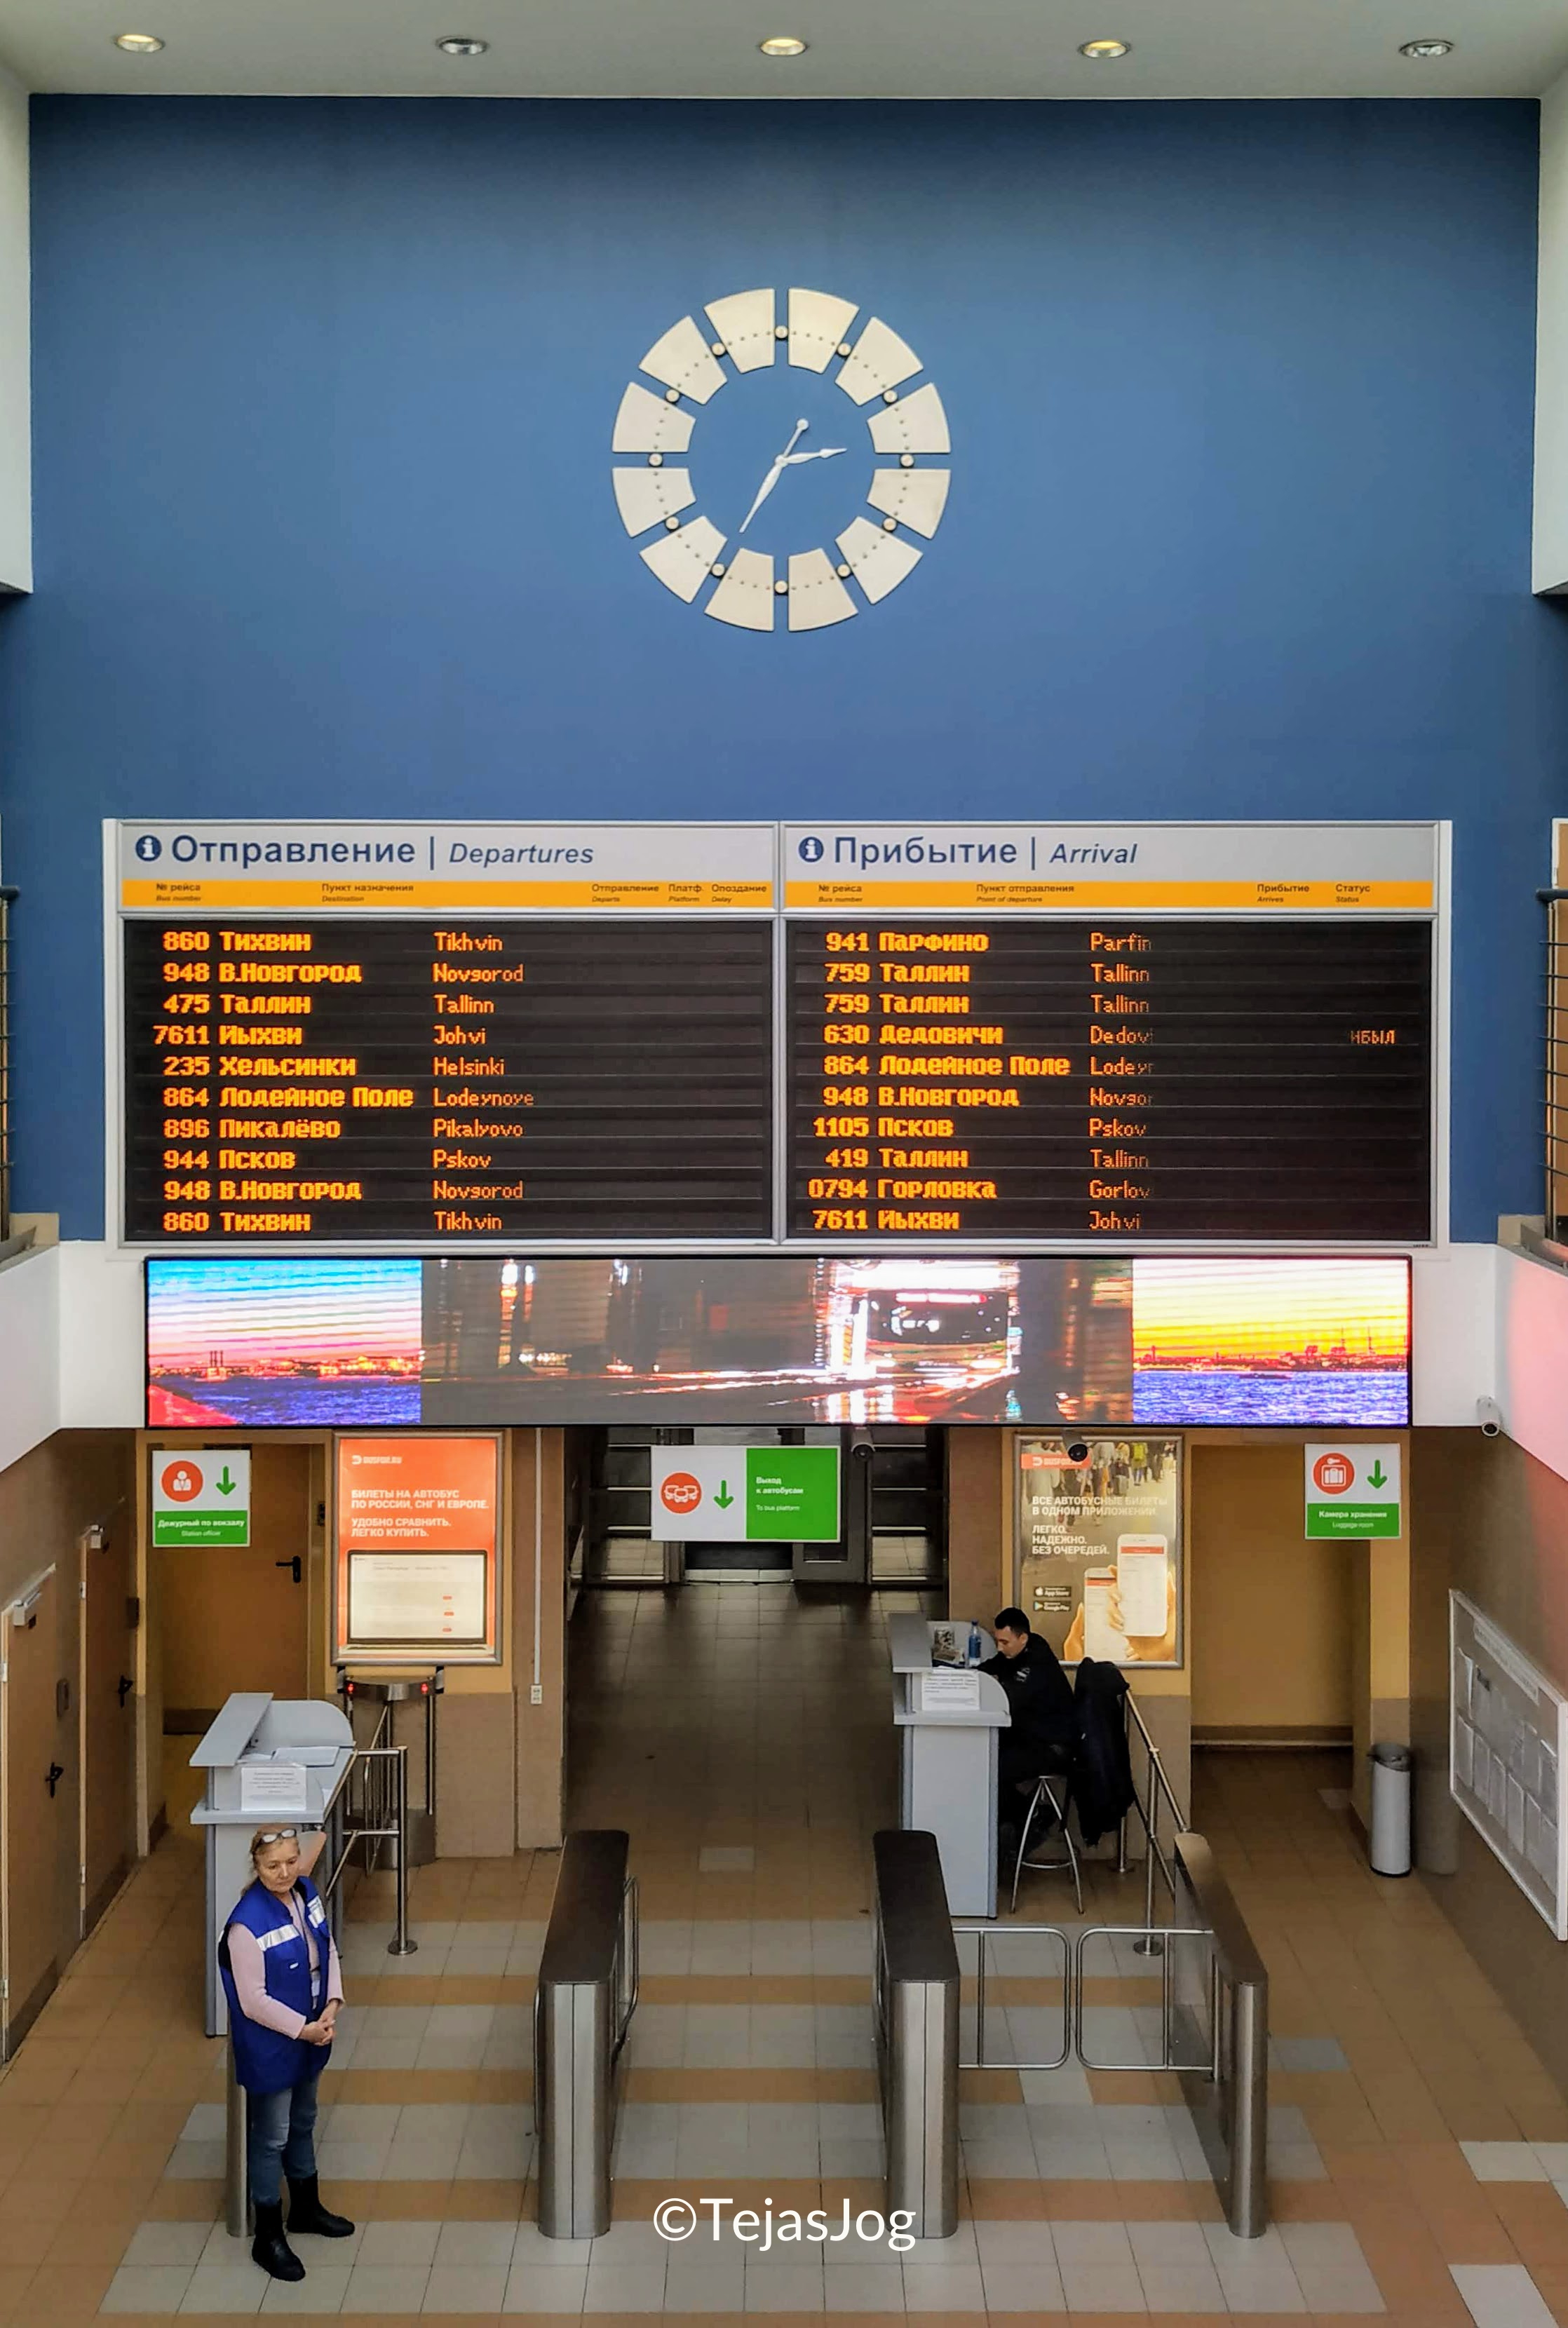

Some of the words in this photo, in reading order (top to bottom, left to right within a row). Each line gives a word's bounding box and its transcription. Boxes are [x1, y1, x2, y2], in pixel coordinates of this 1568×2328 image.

[172, 834, 415, 869] Отправление
[449, 842, 594, 867] Departures
[834, 835, 1018, 870] Прибытие
[1049, 843, 1138, 865] Arrival
[170, 883, 201, 893] рейса
[322, 884, 352, 893] Пункт
[354, 884, 414, 893] назначения
[592, 884, 659, 893] Отправление
[712, 884, 766, 893] Опоздание
[832, 884, 862, 894] рейса
[976, 884, 1006, 894] Пункт
[1008, 884, 1074, 894] отправления
[1257, 884, 1309, 893] Прибытие
[1335, 884, 1370, 894] Статус
[163, 932, 210, 951] 860
[220, 931, 311, 952] Тихвин
[433, 931, 503, 952] Tikhvin
[826, 933, 869, 952] 941
[879, 933, 989, 952] Парфино
[1090, 932, 1151, 952] Parfin
[163, 963, 210, 982] 948
[219, 963, 362, 982] В.Новгород
[825, 963, 870, 982] 759
[879, 963, 970, 982] Таллин
[1090, 962, 1150, 983] Tallinn
[163, 994, 210, 1013] 475
[220, 994, 311, 1013] Таллин
[433, 994, 495, 1014] Tallinn
[825, 994, 870, 1013] 759
[879, 994, 969, 1013] Таллин
[1090, 994, 1150, 1014] Tallinn
[153, 1025, 209, 1045] 7611
[433, 1024, 487, 1045] Johvi
[824, 1025, 870, 1044] 630
[879, 1025, 1003, 1045] Дедовичи
[163, 1057, 210, 1076] 235
[219, 1057, 356, 1076] Хельсинки
[432, 1057, 505, 1076] Helsinki
[824, 1056, 870, 1075] 864
[879, 1055, 1003, 1076] Лодейное
[1009, 1056, 1071, 1076] Поле
[163, 1088, 209, 1107] 864
[219, 1087, 346, 1107] Лодейное
[352, 1087, 414, 1107] Поле
[433, 1088, 534, 1107] Lodeynoye
[823, 1087, 869, 1106] 948
[878, 1087, 1020, 1107] В.Новгород
[163, 1119, 209, 1138] 896
[219, 1118, 341, 1138] Пикалёво
[433, 1118, 523, 1138] Pikalyovo
[813, 1118, 870, 1137] 1105
[877, 1118, 954, 1137] Псков
[1088, 1117, 1147, 1138] Pskov
[163, 1150, 209, 1169] 944
[219, 1150, 295, 1169] Псков
[432, 1149, 492, 1169] Pskov
[825, 1149, 869, 1168] 419
[879, 1148, 968, 1168] Таллин
[1089, 1148, 1149, 1169] Tallinn
[163, 1181, 210, 1200] 948
[219, 1181, 362, 1200] В.Новгород
[808, 1179, 868, 1198] 0794
[877, 1179, 997, 1199] Горловка
[163, 1212, 210, 1231] 860
[220, 1212, 311, 1231] Тихвин
[433, 1210, 503, 1231] Tikhvin
[812, 1210, 868, 1230] 7611
[1088, 1210, 1141, 1231] Johvi
[351, 1489, 395, 1498] БИЛЕТЫ
[396, 1489, 411, 1498] НА
[412, 1489, 460, 1498] АВТОБУС
[763, 1487, 803, 1495] автобусам
[1032, 1496, 1052, 1505] ВСЕ
[1053, 1496, 1123, 1505] АВТОБУСНЫЕ
[351, 1500, 367, 1509] ПО
[368, 1500, 414, 1510] РОССИИ,
[415, 1500, 435, 1509] СНГ
[437, 1500, 445, 1509] И
[447, 1499, 489, 1509] ЕВРОПЕ.
[1032, 1506, 1039, 1516] В
[1041, 1506, 1081, 1517] ОДНОМ
[158, 1520, 201, 1528] Дежурный
[351, 1517, 393, 1528] УДОБНО
[395, 1517, 452, 1527] СРАВНИТЬ.
[351, 1528, 385, 1537] ЛЕГКО
[386, 1528, 430, 1538] КУПИТЬ.
[1032, 1535, 1088, 1545] НАДЕЖНО.
[1032, 1545, 1052, 1555] БЕЗ
[1053, 1544, 1110, 1556] ОЧЕРЕДЕЙ.
